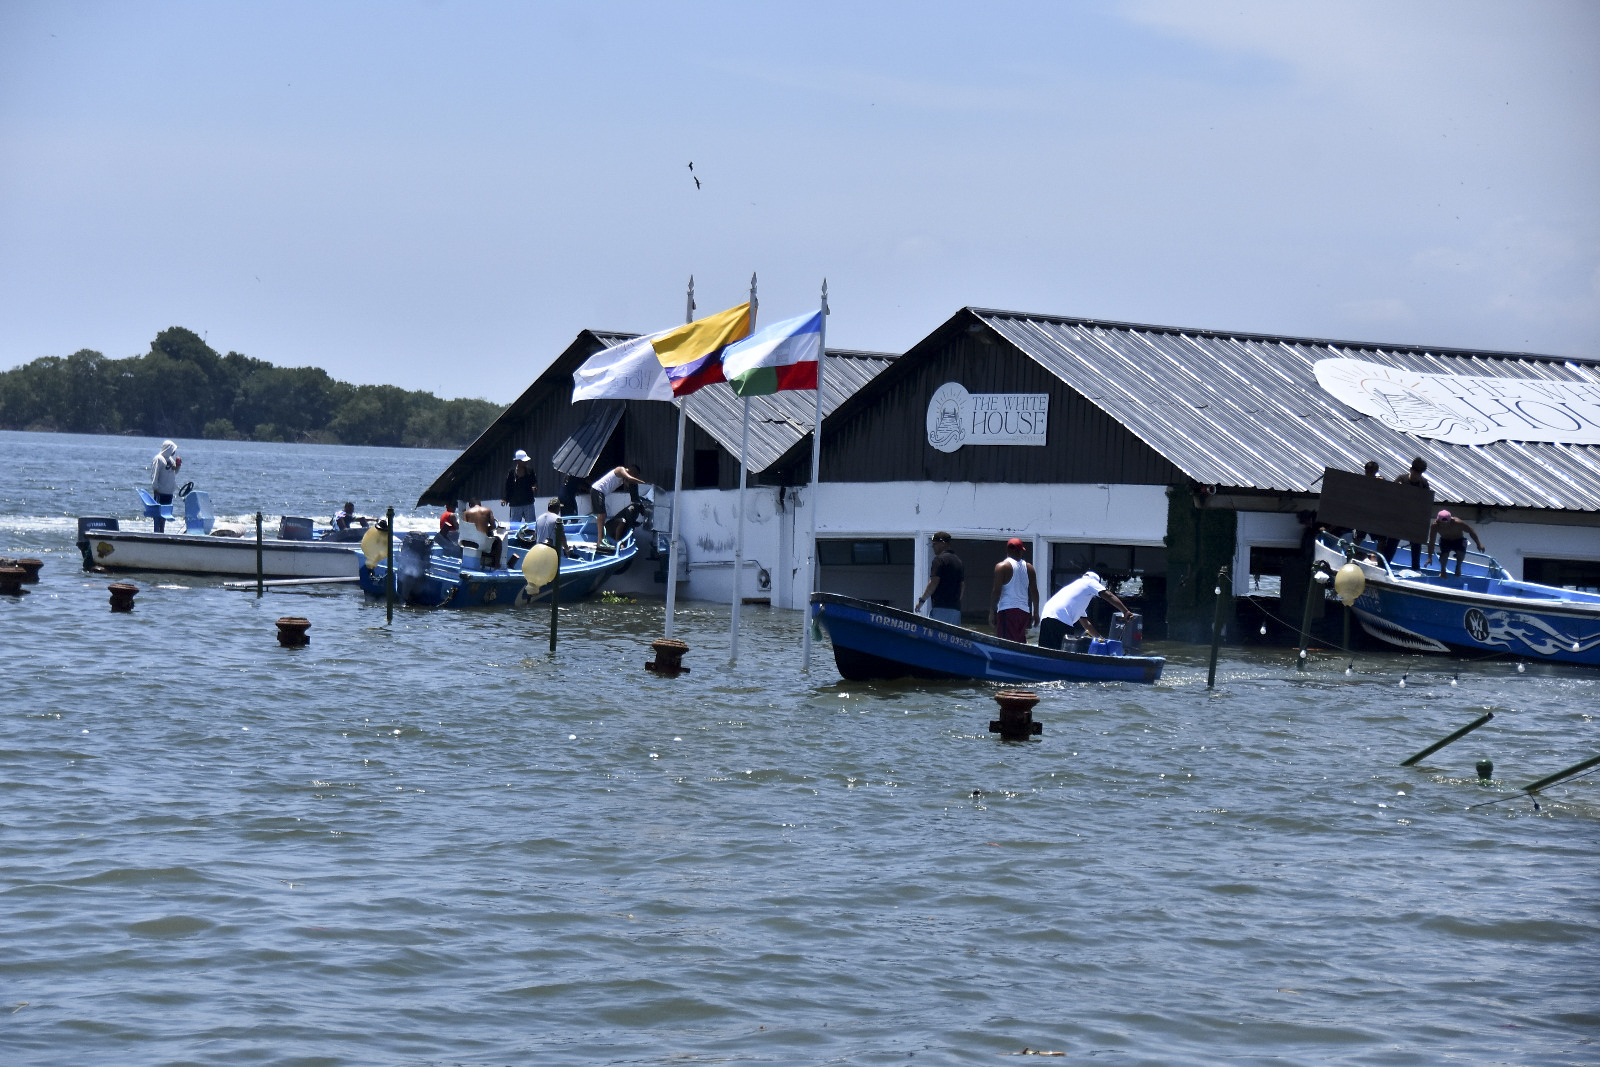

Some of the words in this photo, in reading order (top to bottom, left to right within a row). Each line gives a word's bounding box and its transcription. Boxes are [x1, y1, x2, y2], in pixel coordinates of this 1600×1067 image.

[1420, 376, 1521, 398] THE
[972, 396, 998, 410] THE
[1003, 396, 1047, 411] WHITE
[971, 411, 1045, 435] HOUSE
[869, 613, 917, 632] TORNADO
